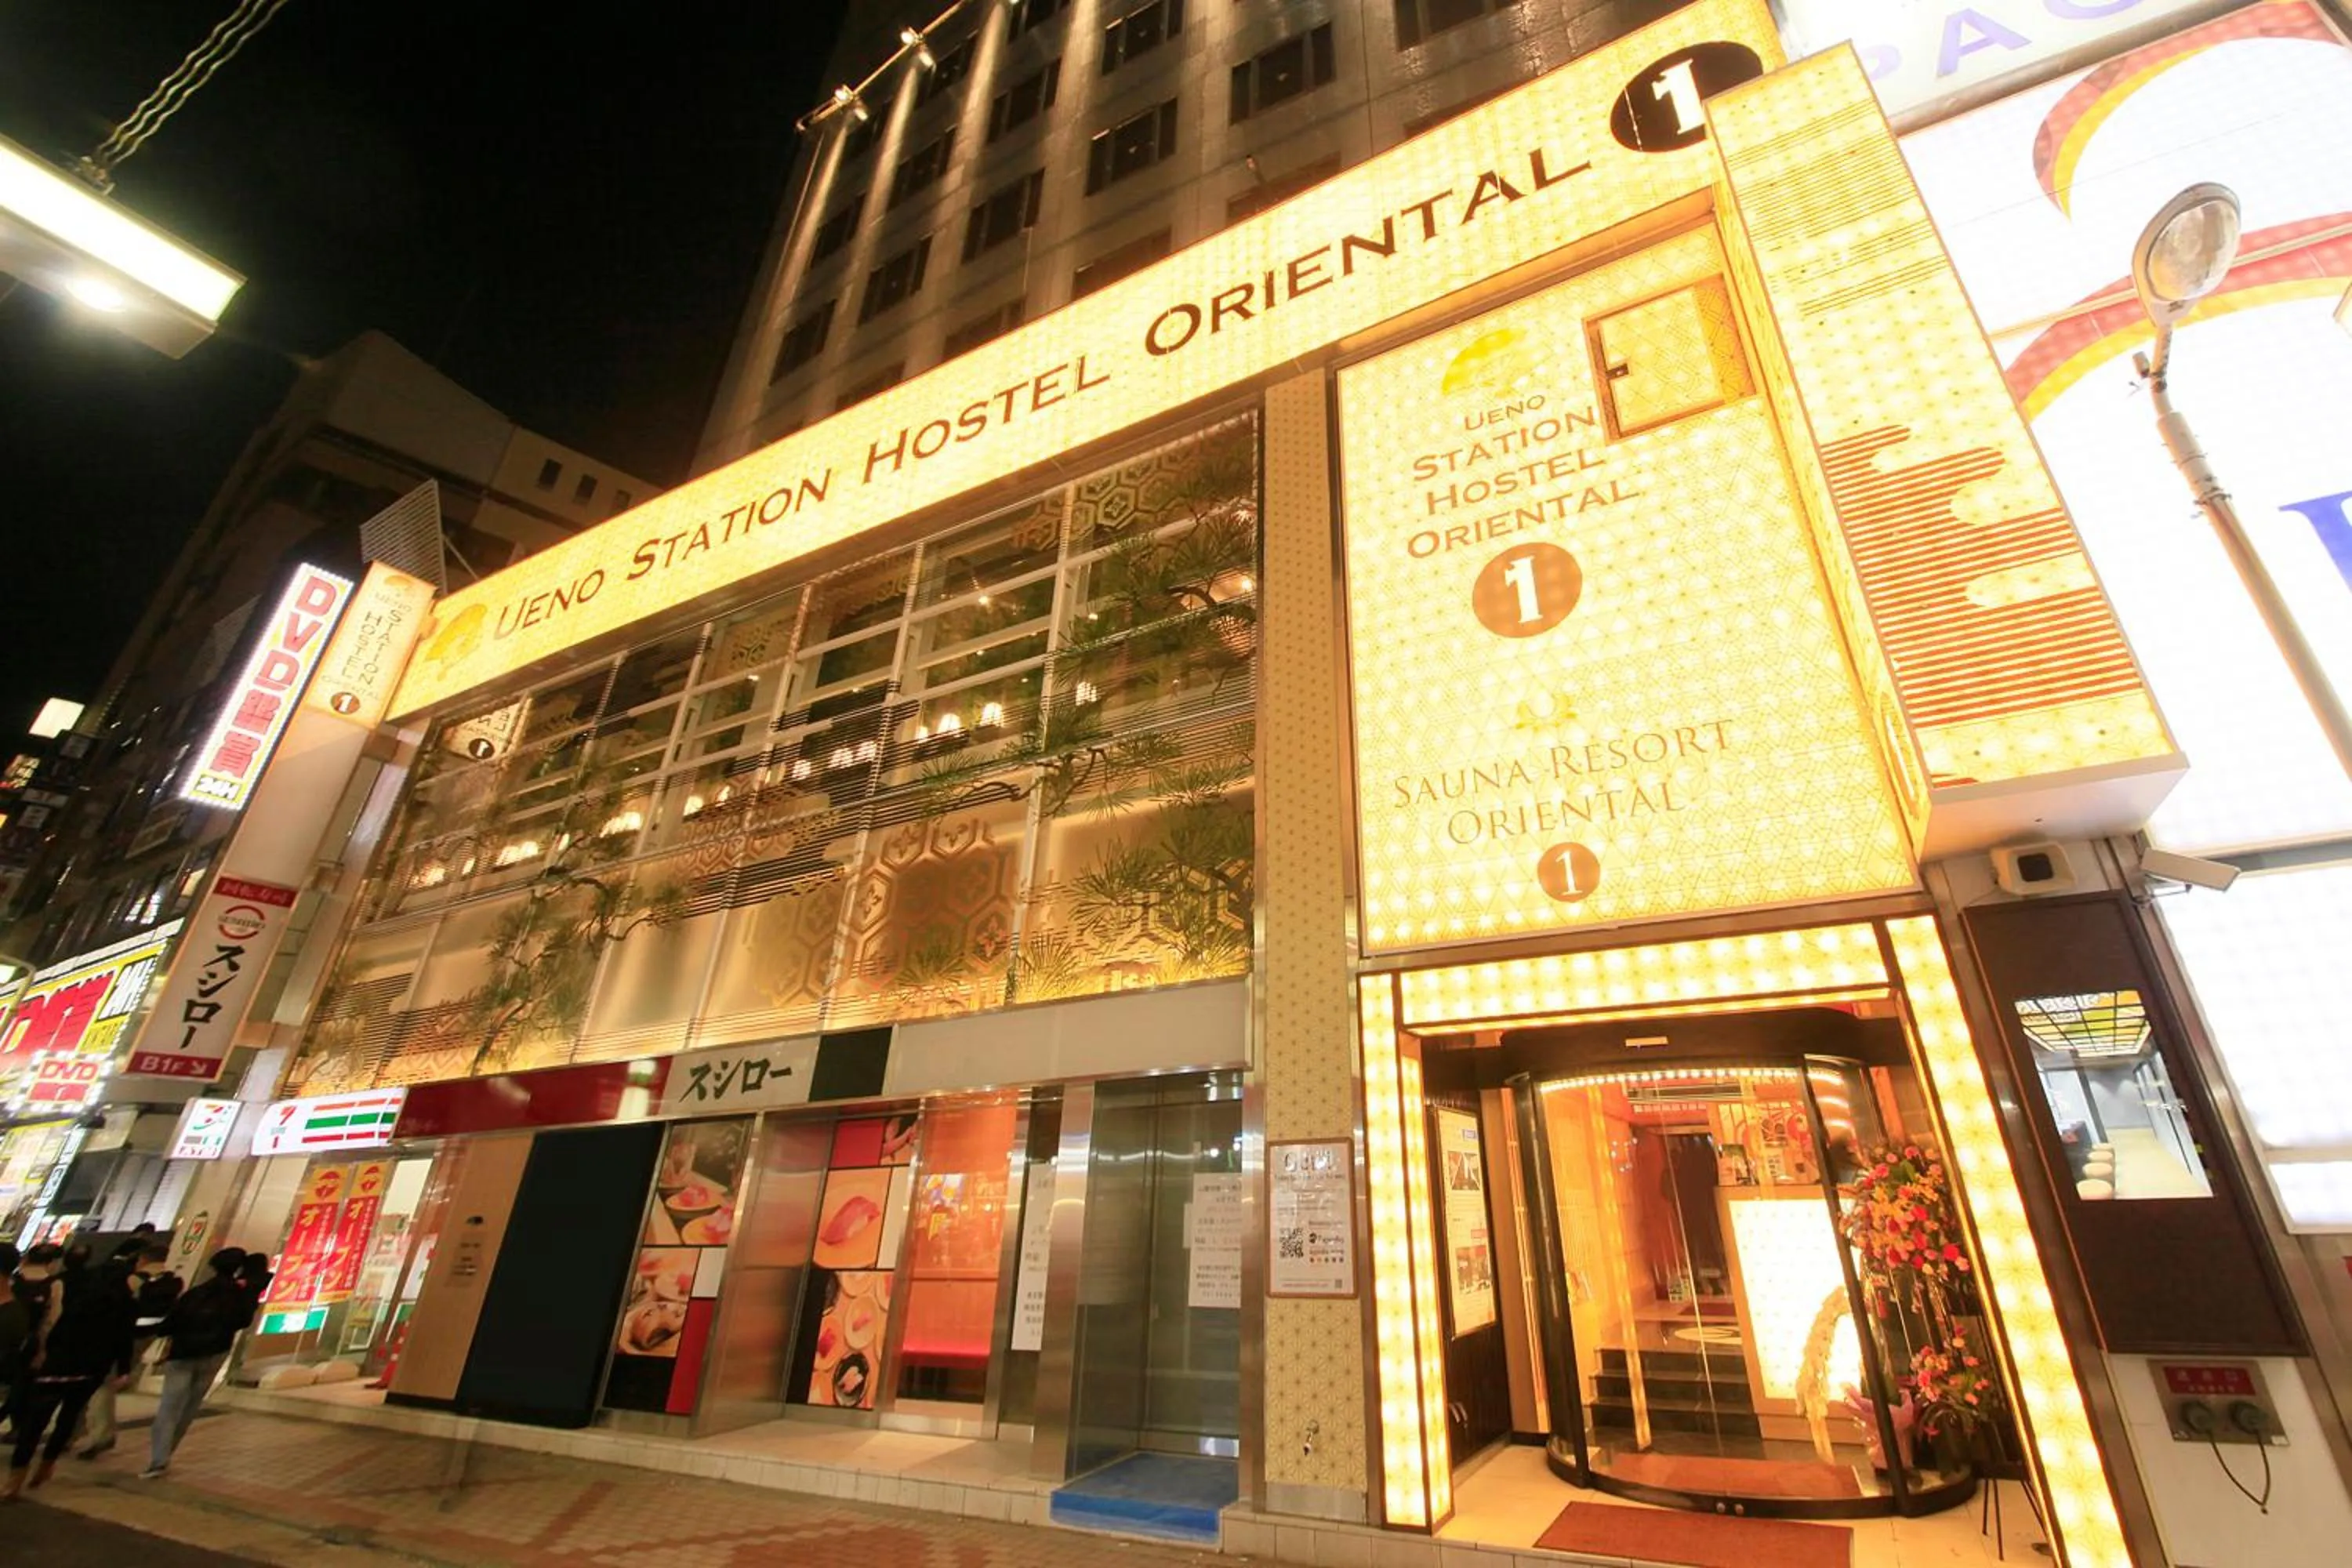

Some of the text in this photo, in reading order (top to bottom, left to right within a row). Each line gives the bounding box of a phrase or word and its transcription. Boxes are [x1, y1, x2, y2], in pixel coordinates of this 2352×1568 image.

[493, 58, 1708, 640] UENO STATION HOSTEL ORIENTAL 1
[1413, 405, 1599, 482] STATION
[1463, 394, 1546, 431] UENO
[1425, 448, 1606, 516] HOSTEL
[1407, 480, 1640, 559] ORIENTAL
[1504, 555, 1544, 624] 1
[342, 611, 383, 679] HOSTEL
[359, 609, 402, 685] STATION
[339, 695, 353, 713] 1
[1394, 719, 1733, 808] SAUNA RESORT
[1448, 782, 1686, 844] ORIENTAL
[1555, 850, 1584, 896] 1
[178, 944, 246, 1049] スシロー
[39, 1058, 100, 1080] DVD
[140, 1056, 183, 1073] B1F
[678, 1056, 793, 1103] スシロー
